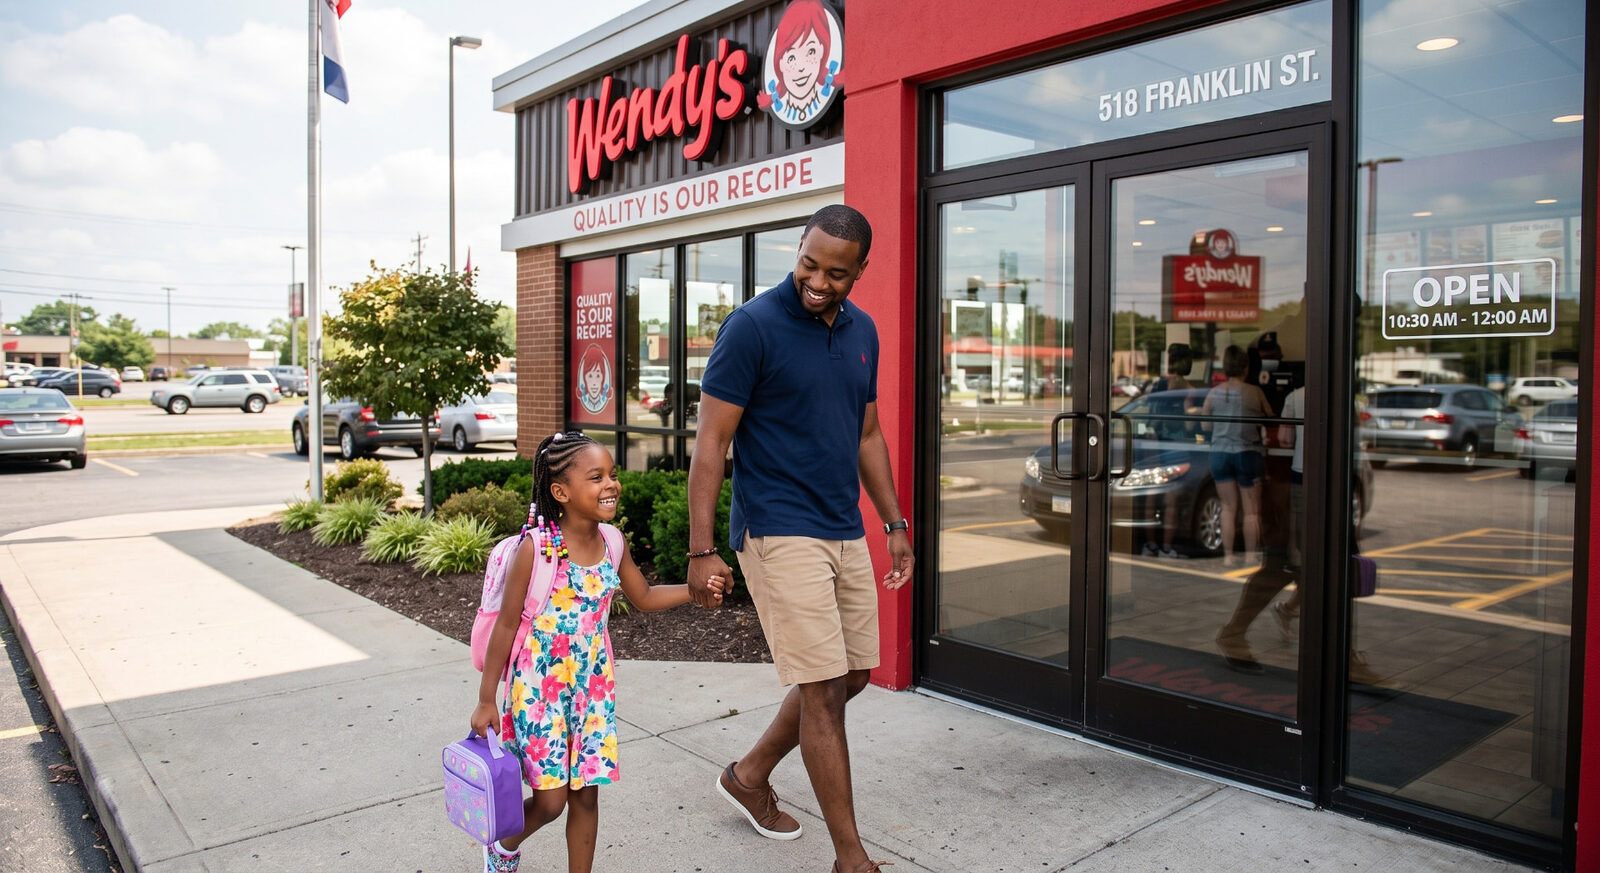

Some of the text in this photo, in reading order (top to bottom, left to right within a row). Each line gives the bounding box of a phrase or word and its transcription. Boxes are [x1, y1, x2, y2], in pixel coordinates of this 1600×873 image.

[1099, 49, 1319, 122] 518 FRANKLIN ST.
[567, 34, 748, 194] Wendy's
[573, 157, 813, 232] QUALITY IS OUR RECIPE
[576, 292, 612, 308] QUALITY
[1412, 271, 1520, 308] OPEN
[576, 306, 612, 325] IS OUR
[1388, 313, 1430, 329] 10:30
[1432, 312, 1458, 327] AM
[1471, 309, 1517, 326] 12:00
[1519, 308, 1548, 324] AM
[576, 323, 612, 340] RECIPE
